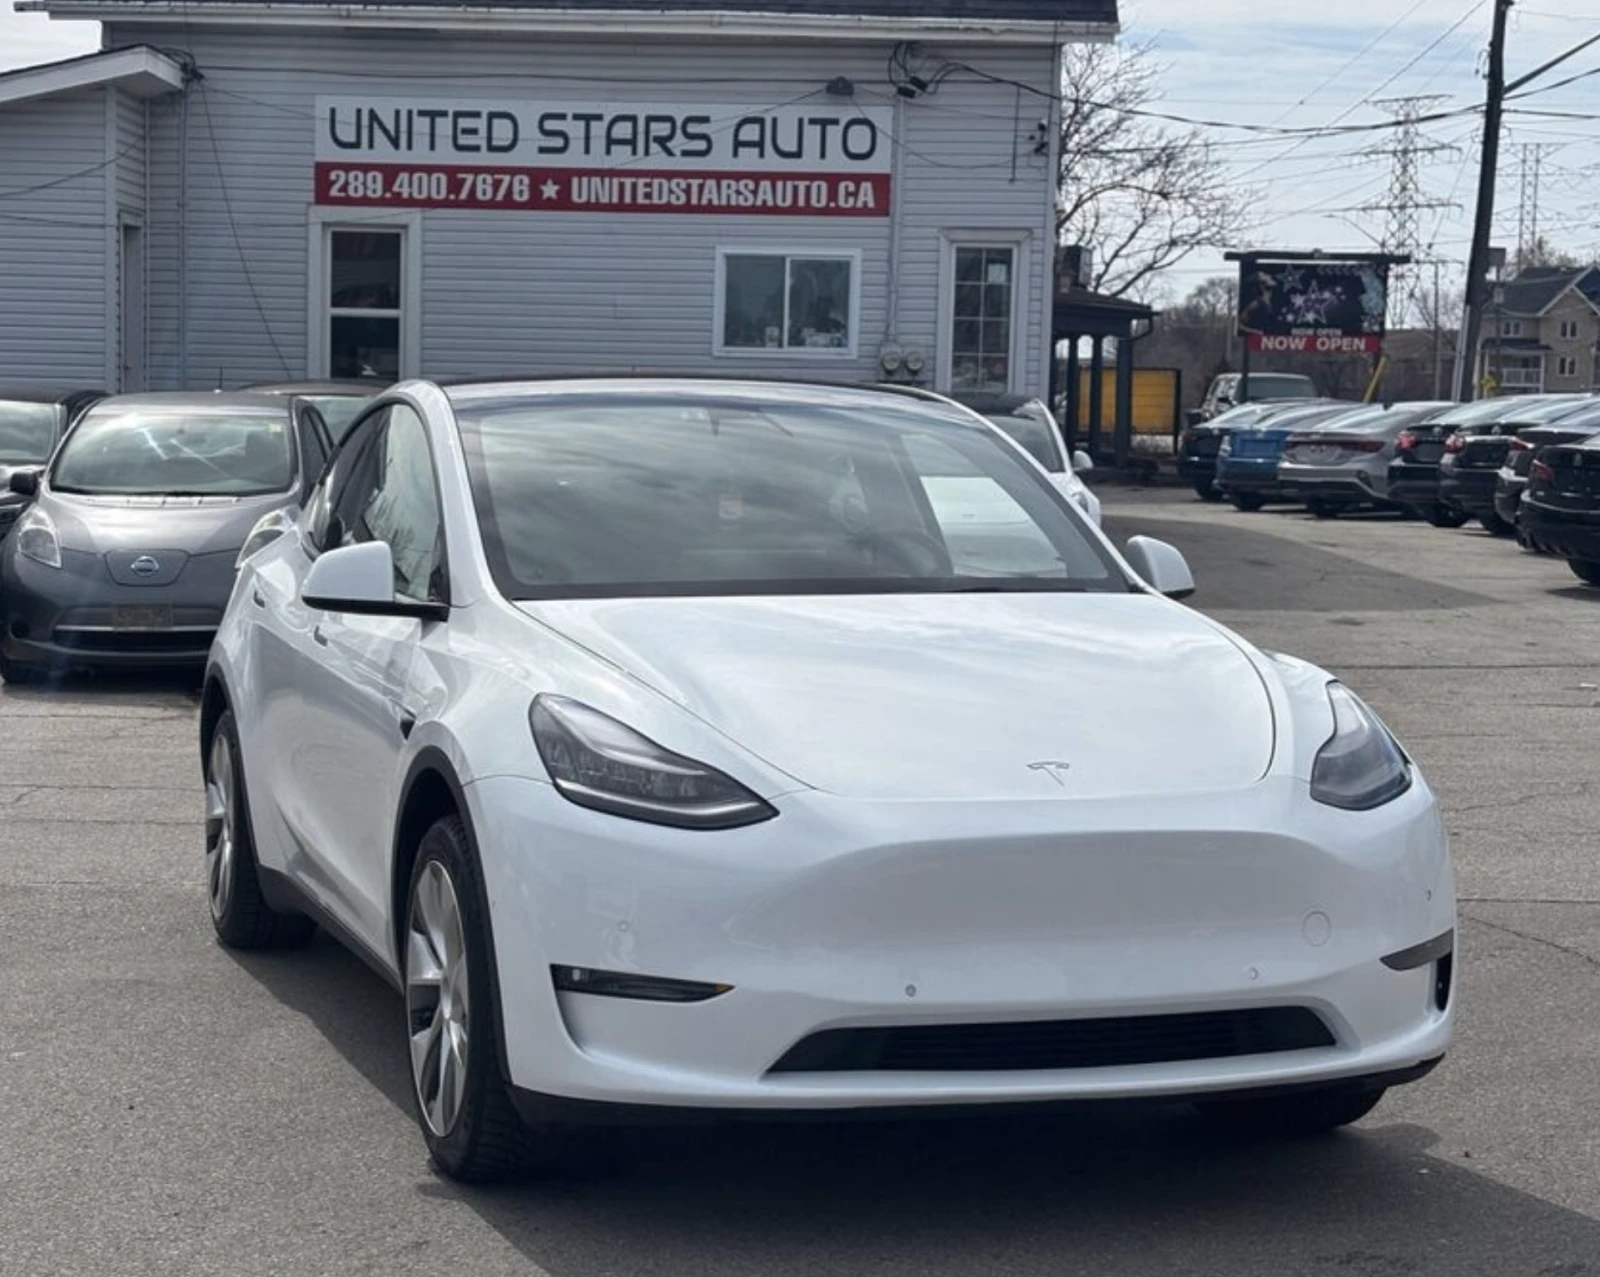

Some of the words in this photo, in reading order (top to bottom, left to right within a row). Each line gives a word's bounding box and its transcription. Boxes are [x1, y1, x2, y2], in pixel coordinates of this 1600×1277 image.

[329, 106, 519, 153] UNITED
[537, 112, 712, 157] STARS
[732, 116, 878, 161] AUTO
[328, 169, 530, 202] 289.400.7676
[571, 176, 876, 209] UNITEDSTARSAUTO.CA
[1261, 337, 1307, 350] NOW
[1316, 337, 1366, 351] OPEN
